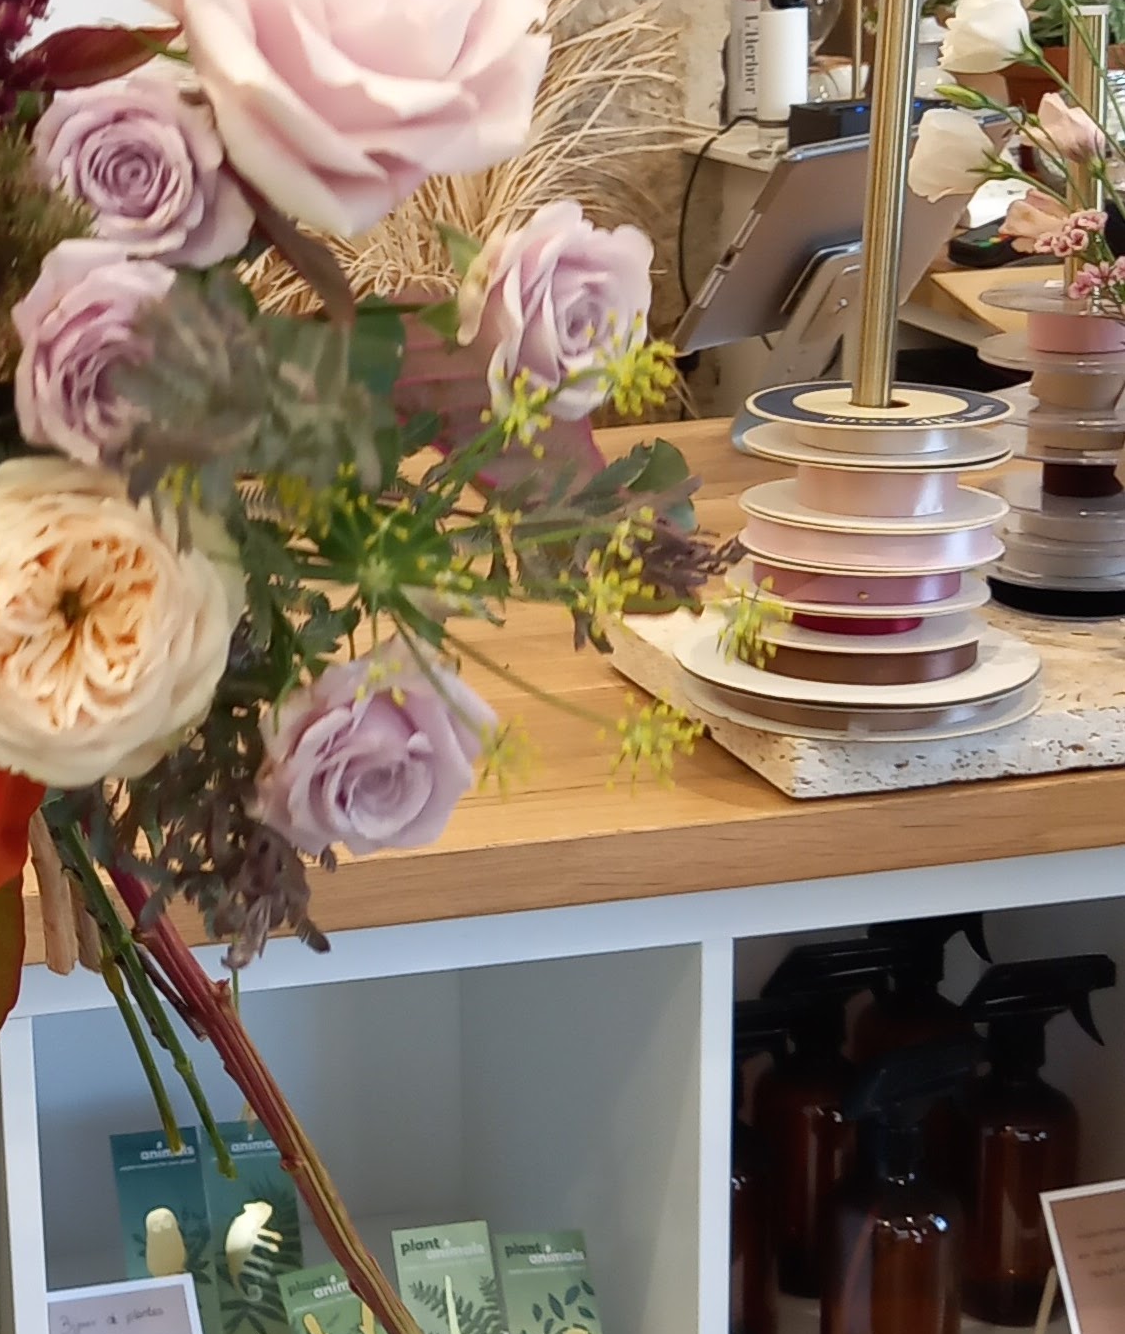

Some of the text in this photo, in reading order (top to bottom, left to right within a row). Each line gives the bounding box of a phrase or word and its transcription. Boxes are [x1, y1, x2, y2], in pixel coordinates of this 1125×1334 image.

[744, 15, 759, 95] L'Herbier
[139, 1141, 196, 1161] animls
[230, 1133, 277, 1153] anima
[400, 1237, 441, 1257] plant
[426, 1239, 485, 1260] animals
[504, 1242, 543, 1259] plant
[528, 1244, 586, 1265] animals
[313, 1274, 350, 1299] anim
